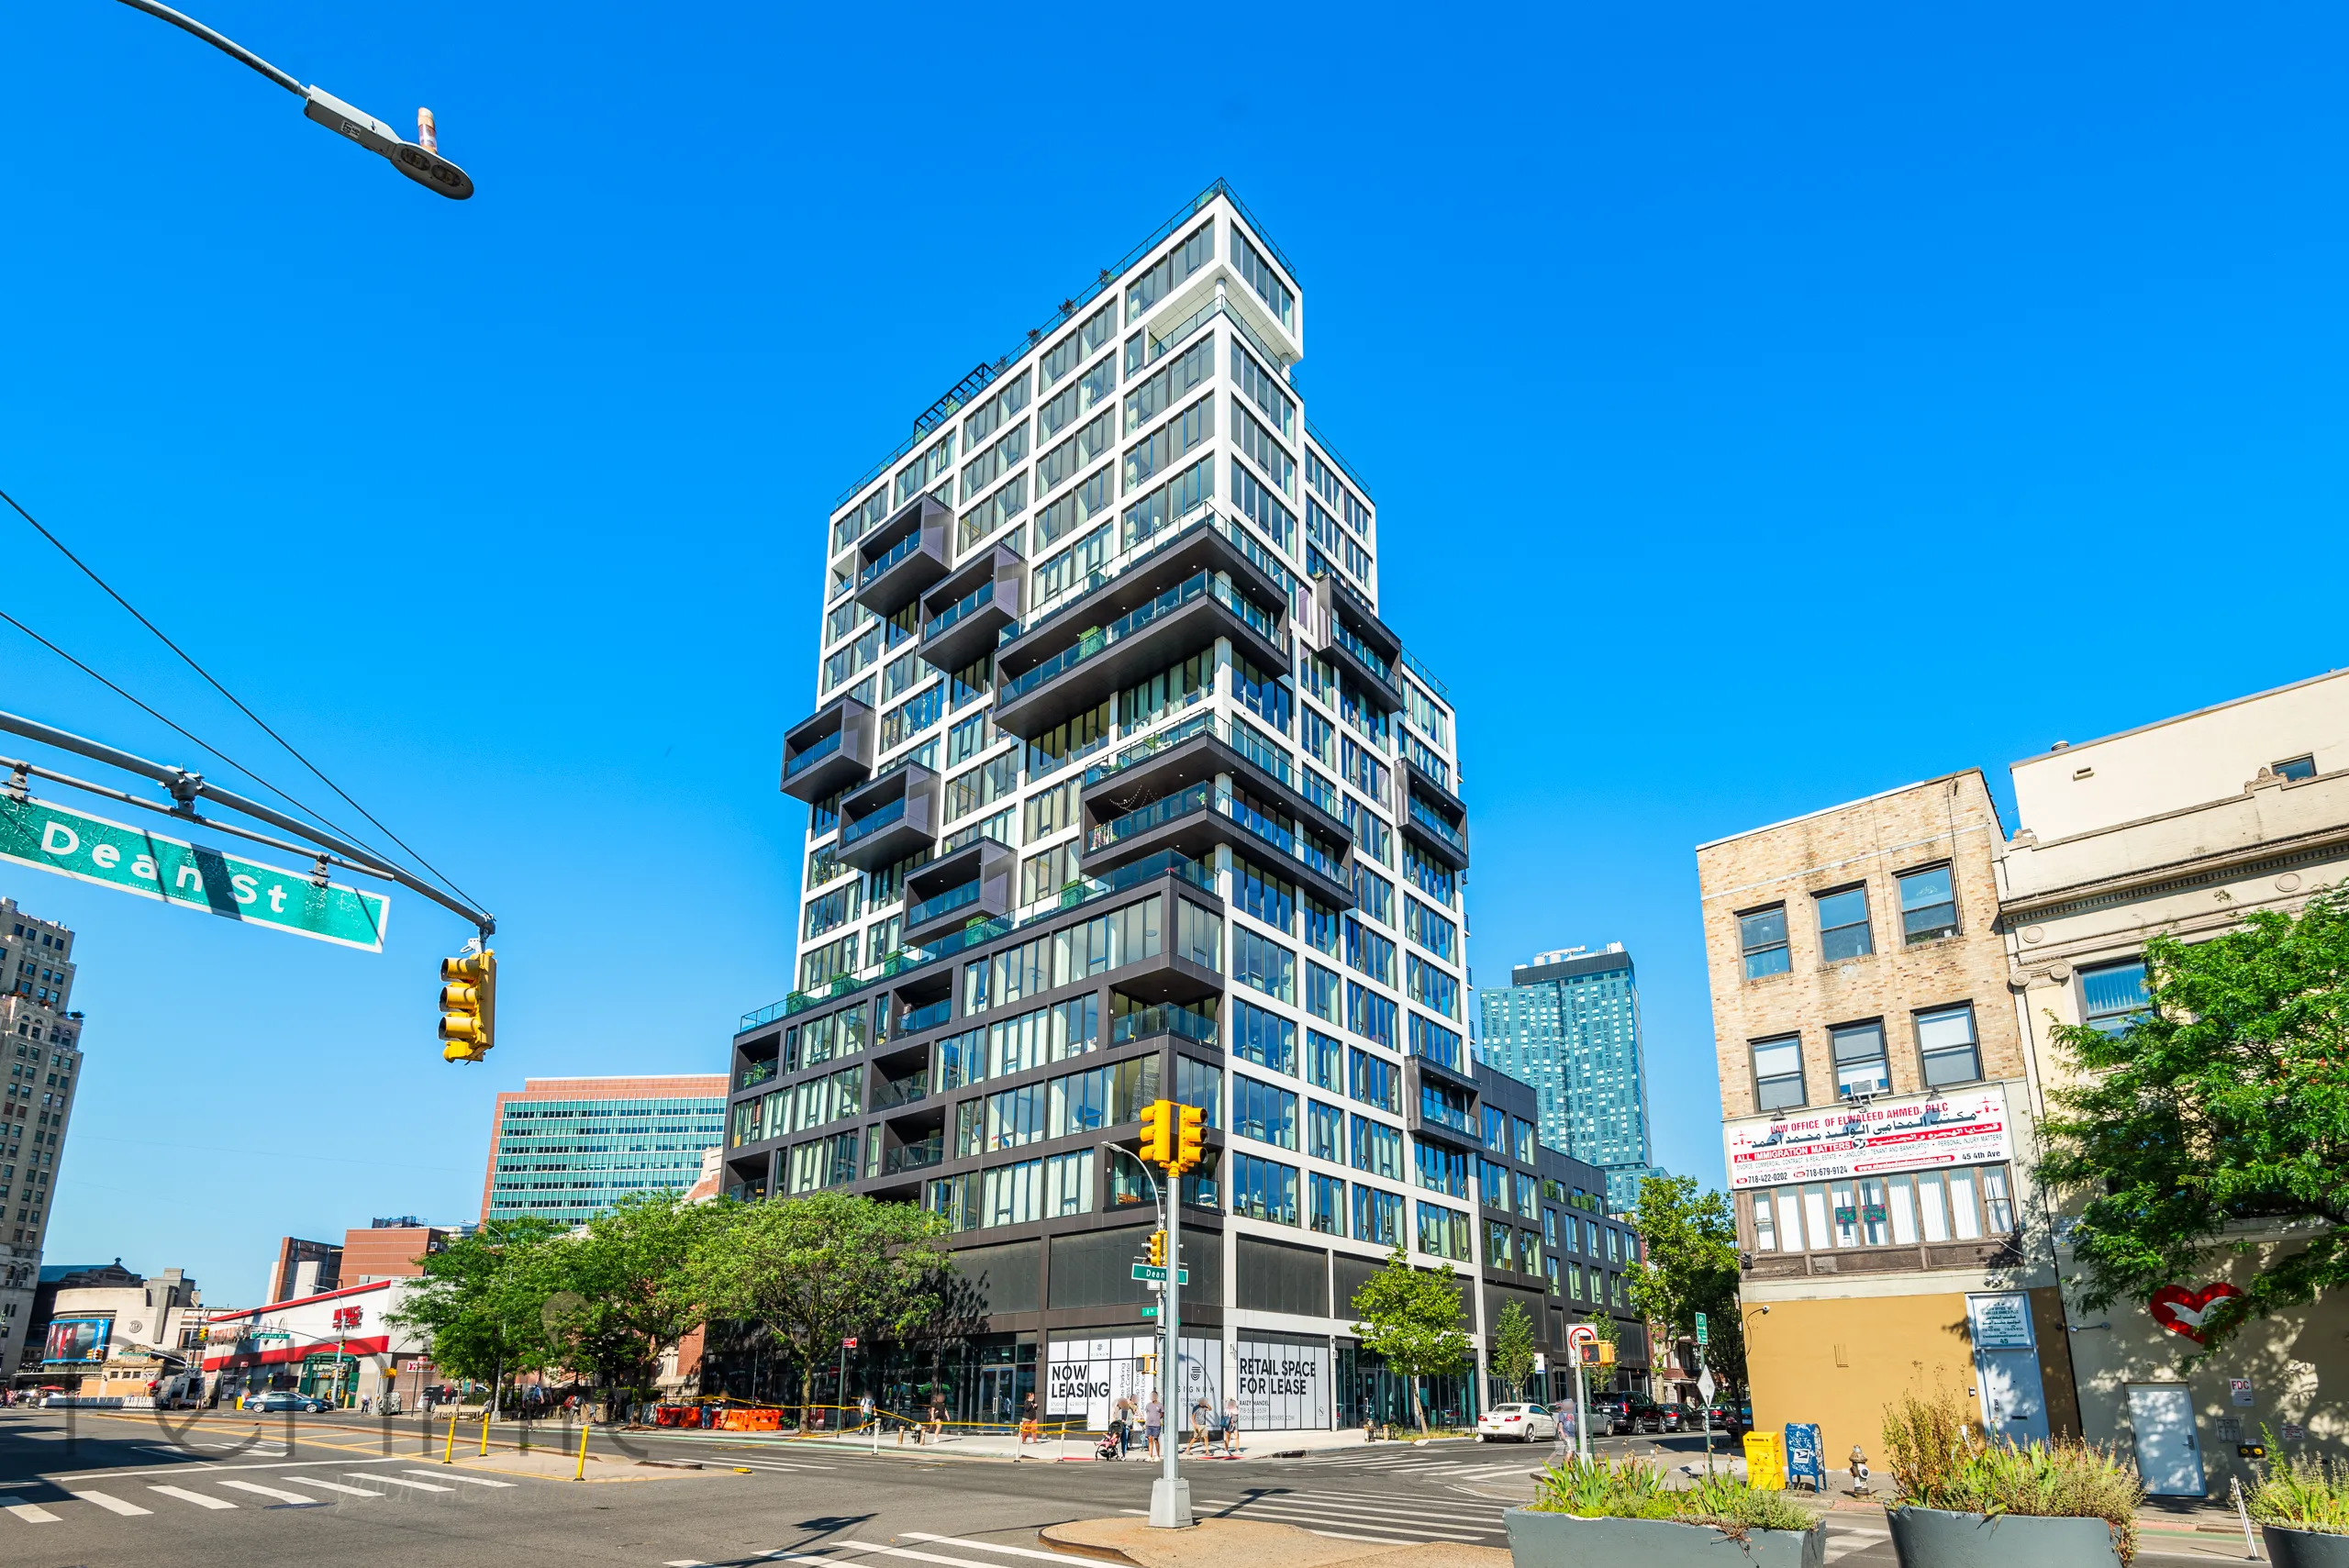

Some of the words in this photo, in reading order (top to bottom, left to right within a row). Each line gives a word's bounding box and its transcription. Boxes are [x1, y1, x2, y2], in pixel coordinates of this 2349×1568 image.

[39, 819, 203, 894] Dean
[228, 873, 288, 914] St
[1770, 1124, 1788, 1134] LAW
[1791, 1119, 1820, 1132] OFFICE
[1824, 1118, 1835, 1128] OF
[1838, 1109, 1884, 1126] ELWALEED
[1925, 1102, 1949, 1114] PLLC
[1931, 1110, 1977, 1129] مكتب
[1937, 1139, 1962, 1147] PERSONAL
[1964, 1136, 1979, 1144] INJURY
[1980, 1133, 2003, 1141] MATTERS
[1736, 1153, 1753, 1163] ALL
[1753, 1147, 1809, 1161] IMMIGRATION
[1811, 1141, 1851, 1154] MATTERS
[1870, 1147, 1887, 1155] TENANT
[1974, 1151, 1986, 1159] 4th
[1987, 1150, 2000, 1158] Ave
[1747, 1172, 1788, 1184] 718-422-0202
[1805, 1165, 1848, 1177] 718-679-9124
[1146, 1268, 1165, 1279] Dean
[1052, 1364, 1088, 1381] NOW
[1240, 1358, 1279, 1375] RETAIL
[1281, 1360, 1316, 1377] SPACE
[1051, 1382, 1110, 1398] LEASING
[1240, 1377, 1266, 1395] FOR
[1271, 1378, 1307, 1396] LEASE
[2231, 1380, 2250, 1390] FDC
